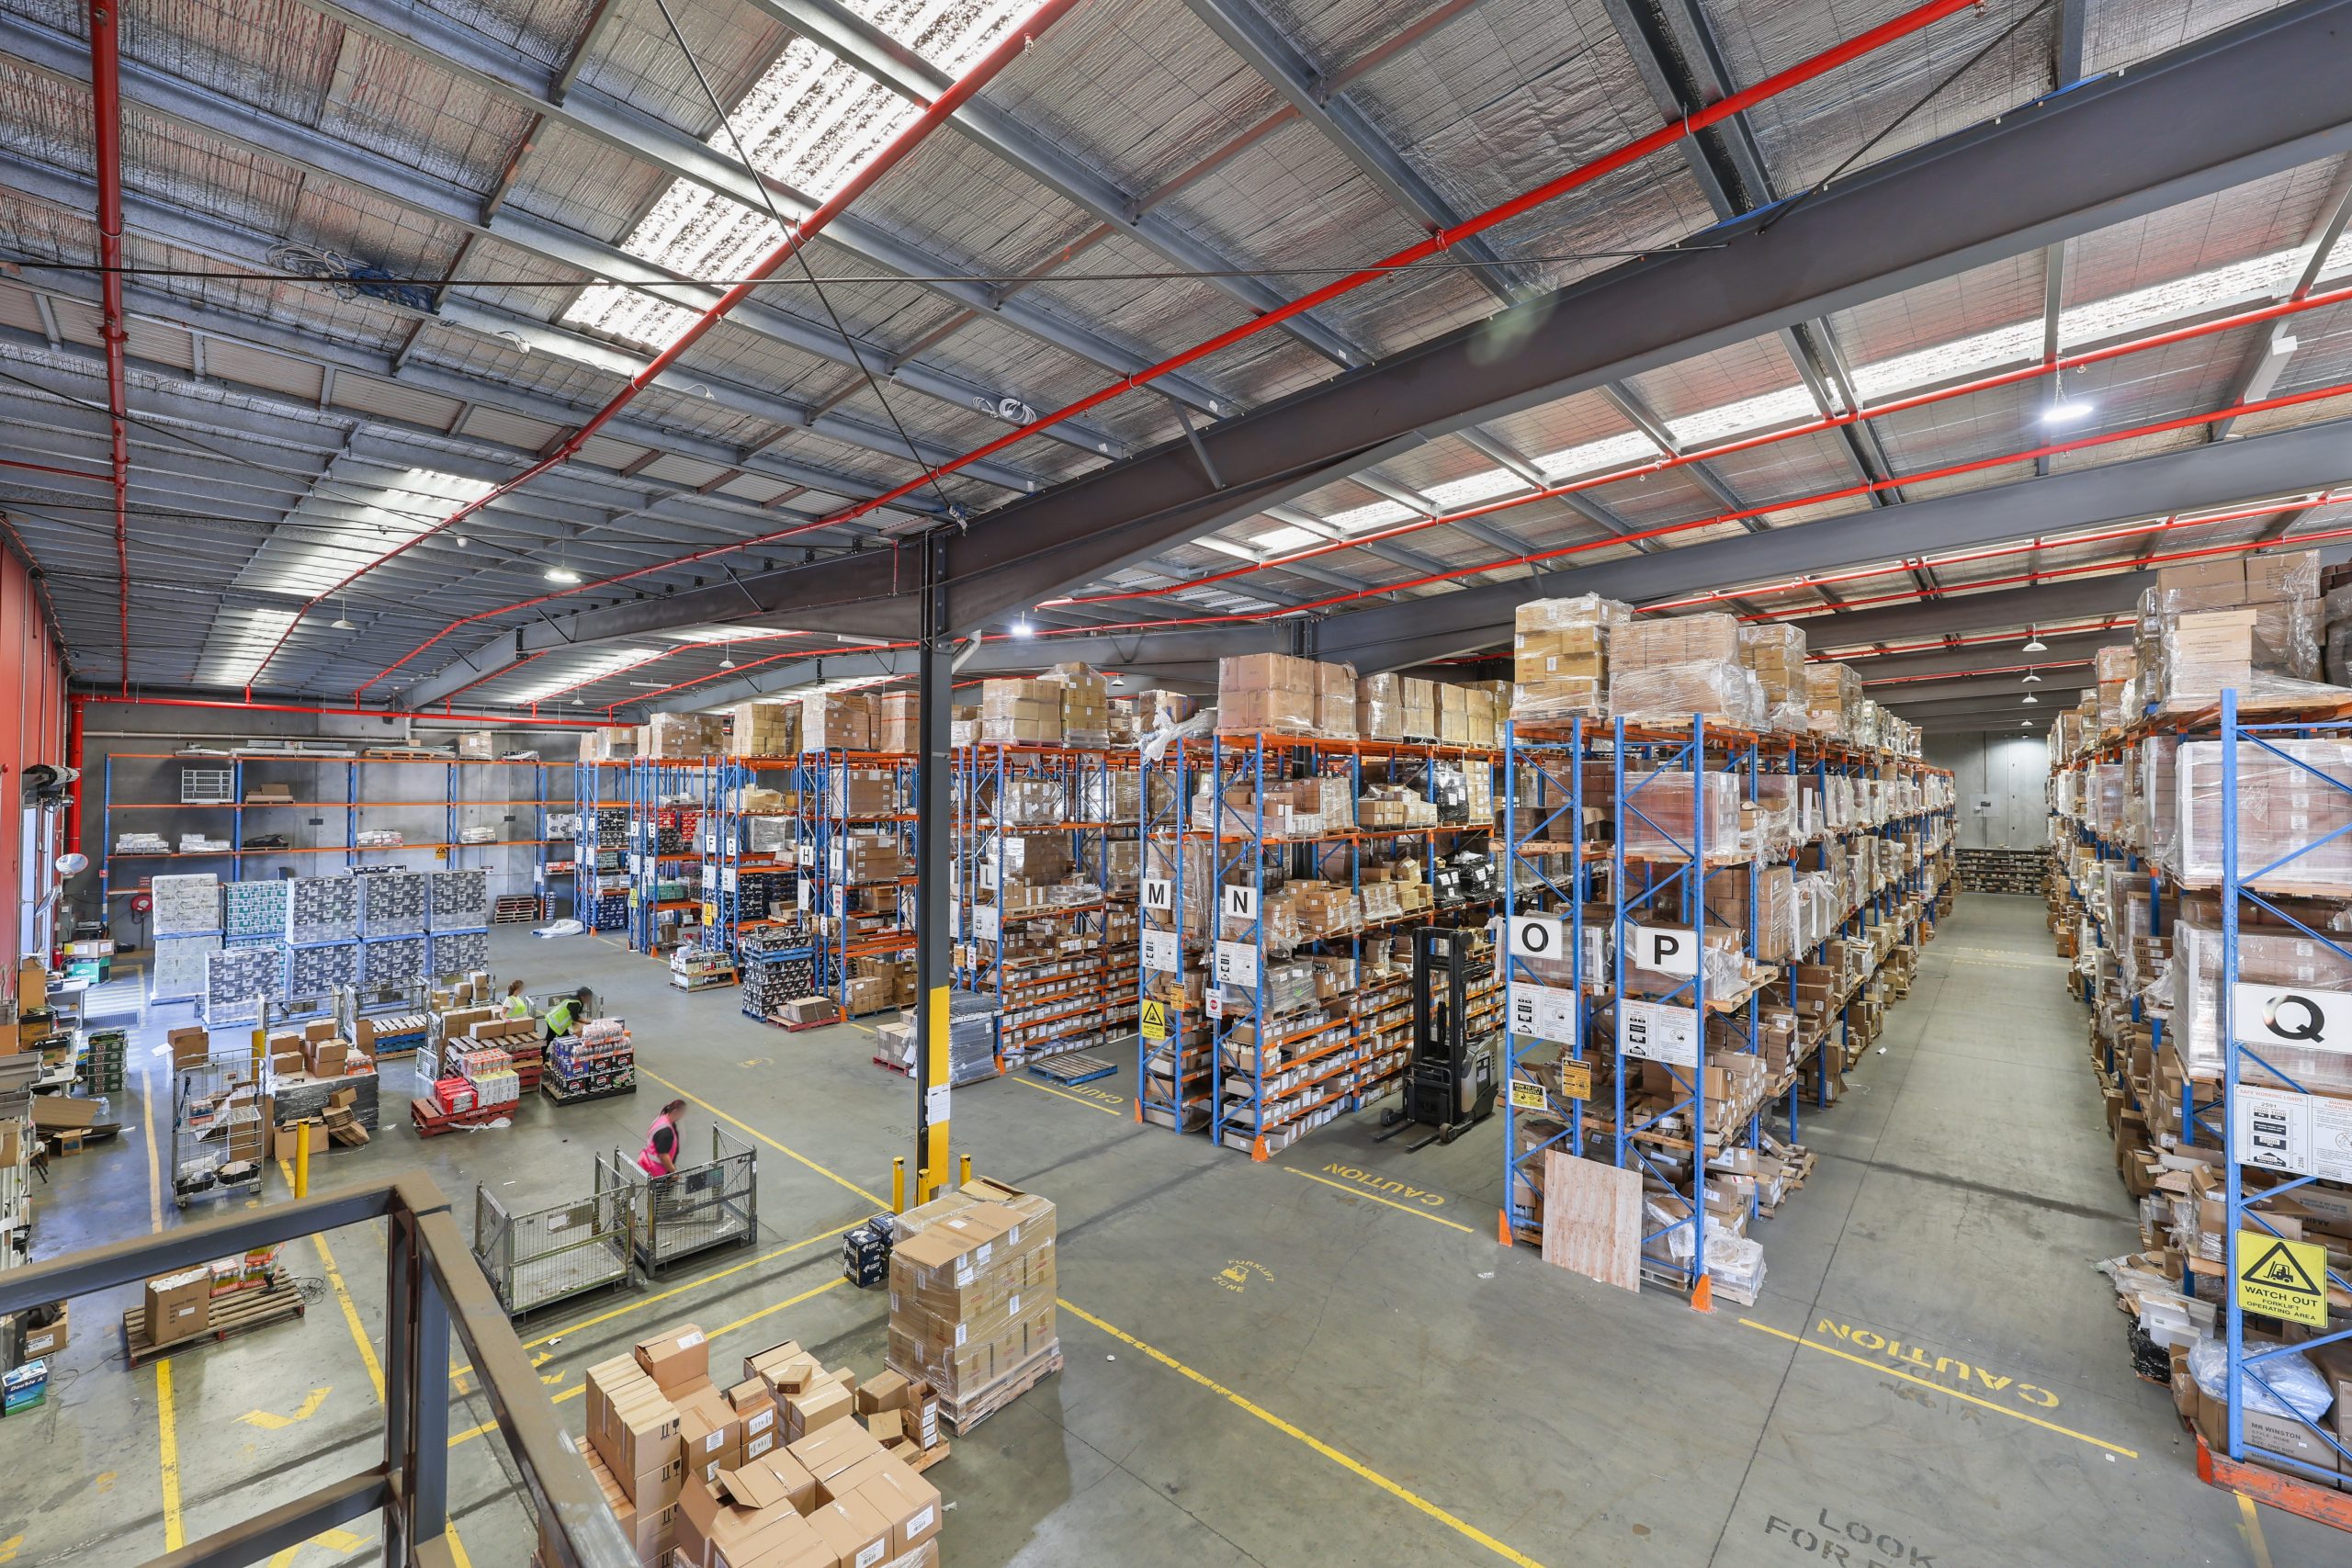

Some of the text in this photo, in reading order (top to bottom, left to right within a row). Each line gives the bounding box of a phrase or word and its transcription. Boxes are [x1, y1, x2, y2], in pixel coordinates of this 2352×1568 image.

[708, 838, 714, 850] F
[729, 840, 734, 853] G
[803, 848, 810, 863] H
[986, 868, 992, 886] L
[1148, 883, 1164, 905] M
[1233, 890, 1248, 914] N
[1521, 922, 1549, 953] O
[1654, 934, 1679, 965] P
[2262, 995, 2325, 1043] Q
[2255, 1091, 2282, 1100] WORKING
[1323, 1163, 1446, 1206] CAUTION
[1227, 1258, 1275, 1283] FORKLIFT
[1212, 1275, 1245, 1293] ZONE
[2245, 1286, 2318, 1307] WATCH OUT
[2262, 1299, 2300, 1311] FORKLIFT
[2247, 1301, 2315, 1321] OPERATING AREA
[1817, 1318, 2059, 1407] CAUTION
[10, 1380, 35, 1392] Double
[2251, 1422, 2264, 1430] MR
[2266, 1426, 2301, 1440] WINSTON
[1764, 1515, 1850, 1568] FOR
[1819, 1507, 1937, 1568] LOOK
